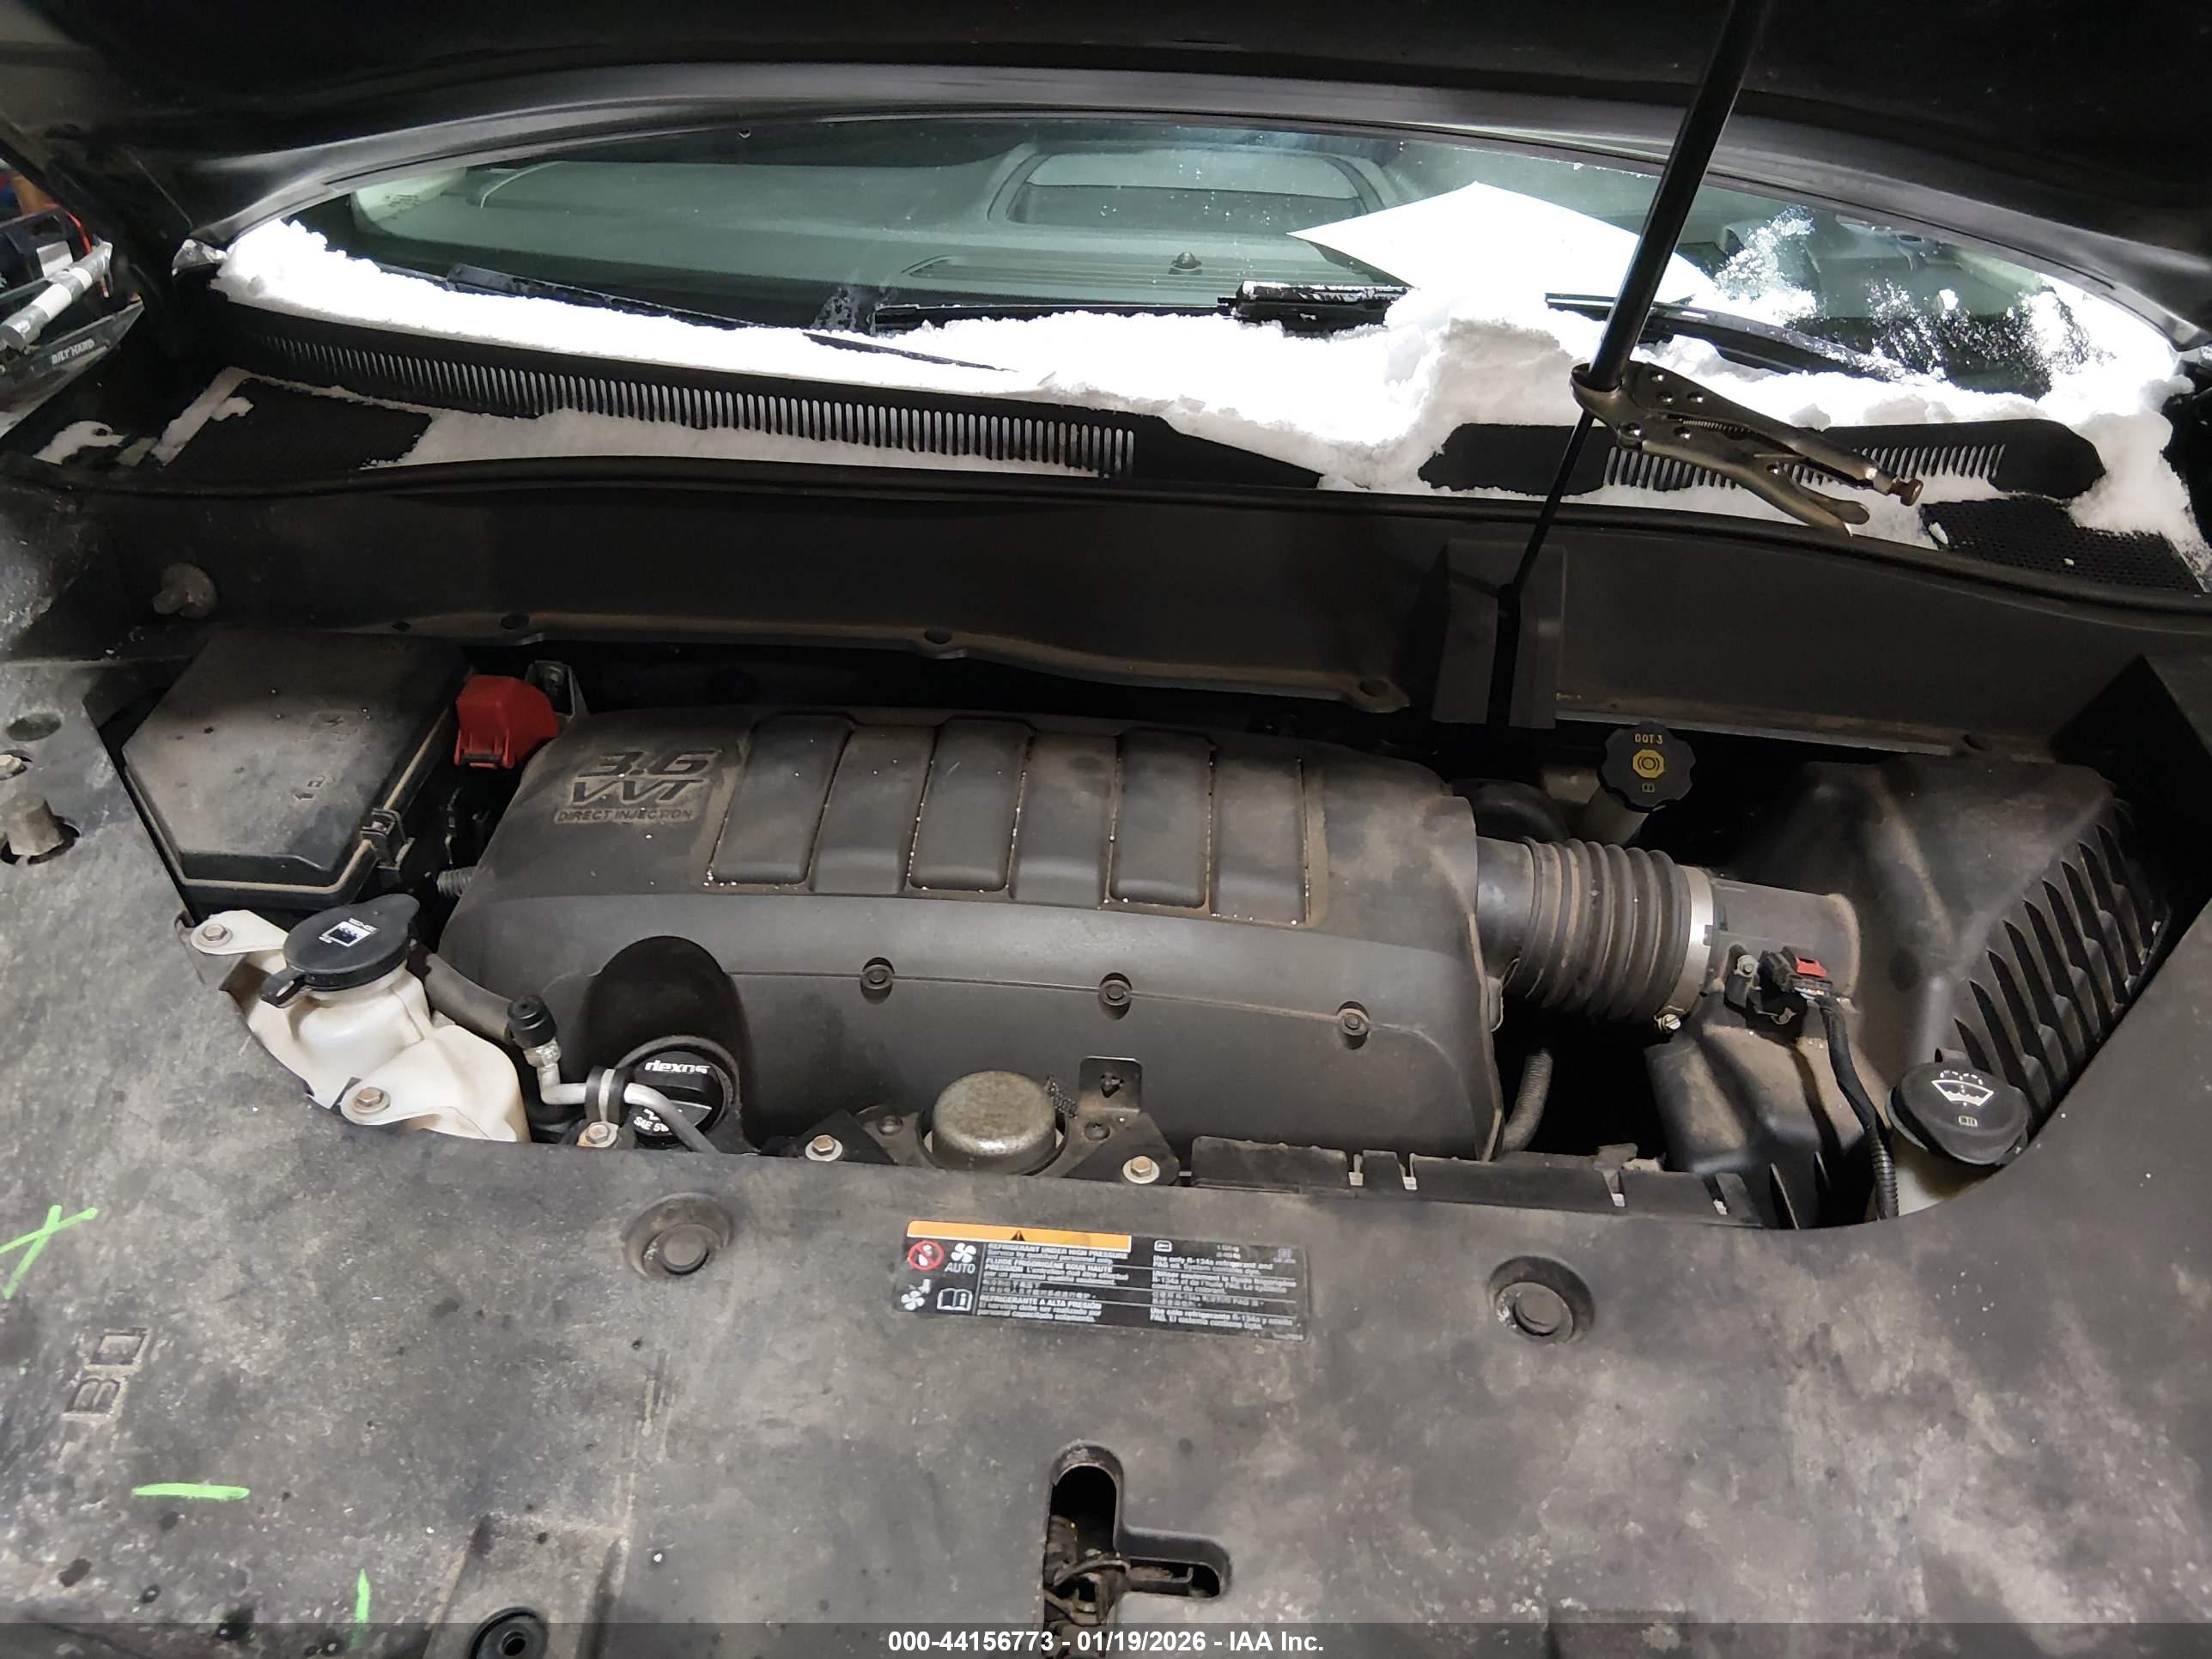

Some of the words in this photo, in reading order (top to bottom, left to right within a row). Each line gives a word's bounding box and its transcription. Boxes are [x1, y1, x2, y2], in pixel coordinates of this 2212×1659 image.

[1635, 733, 1655, 744] DOT
[1656, 734, 1663, 744] 3
[577, 749, 719, 777] 3.6
[571, 779, 704, 803] VVT
[557, 810, 611, 822] DIRECT
[615, 810, 693, 821] INJECTION
[644, 1060, 711, 1074] dexos
[634, 1116, 653, 1130] SAE
[945, 1262, 975, 1274] AUTO
